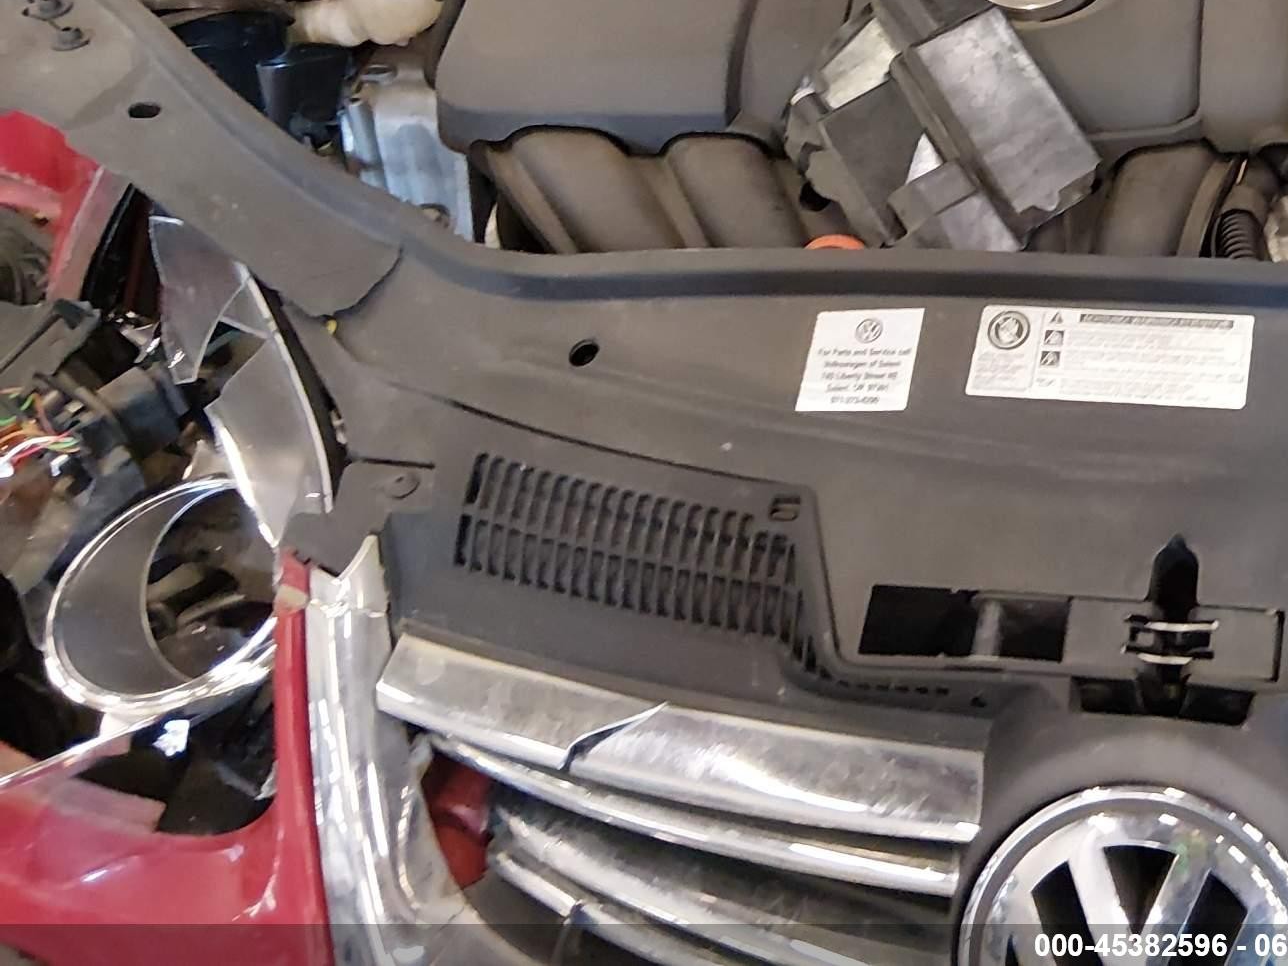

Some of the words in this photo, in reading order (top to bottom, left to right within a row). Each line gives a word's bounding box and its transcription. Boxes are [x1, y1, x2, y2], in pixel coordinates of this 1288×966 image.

[832, 347, 852, 356] Parts
[853, 347, 867, 356] and
[869, 347, 897, 356] Service
[823, 360, 867, 370] Volkswagen
[869, 360, 878, 368] of
[878, 360, 902, 368] Salem
